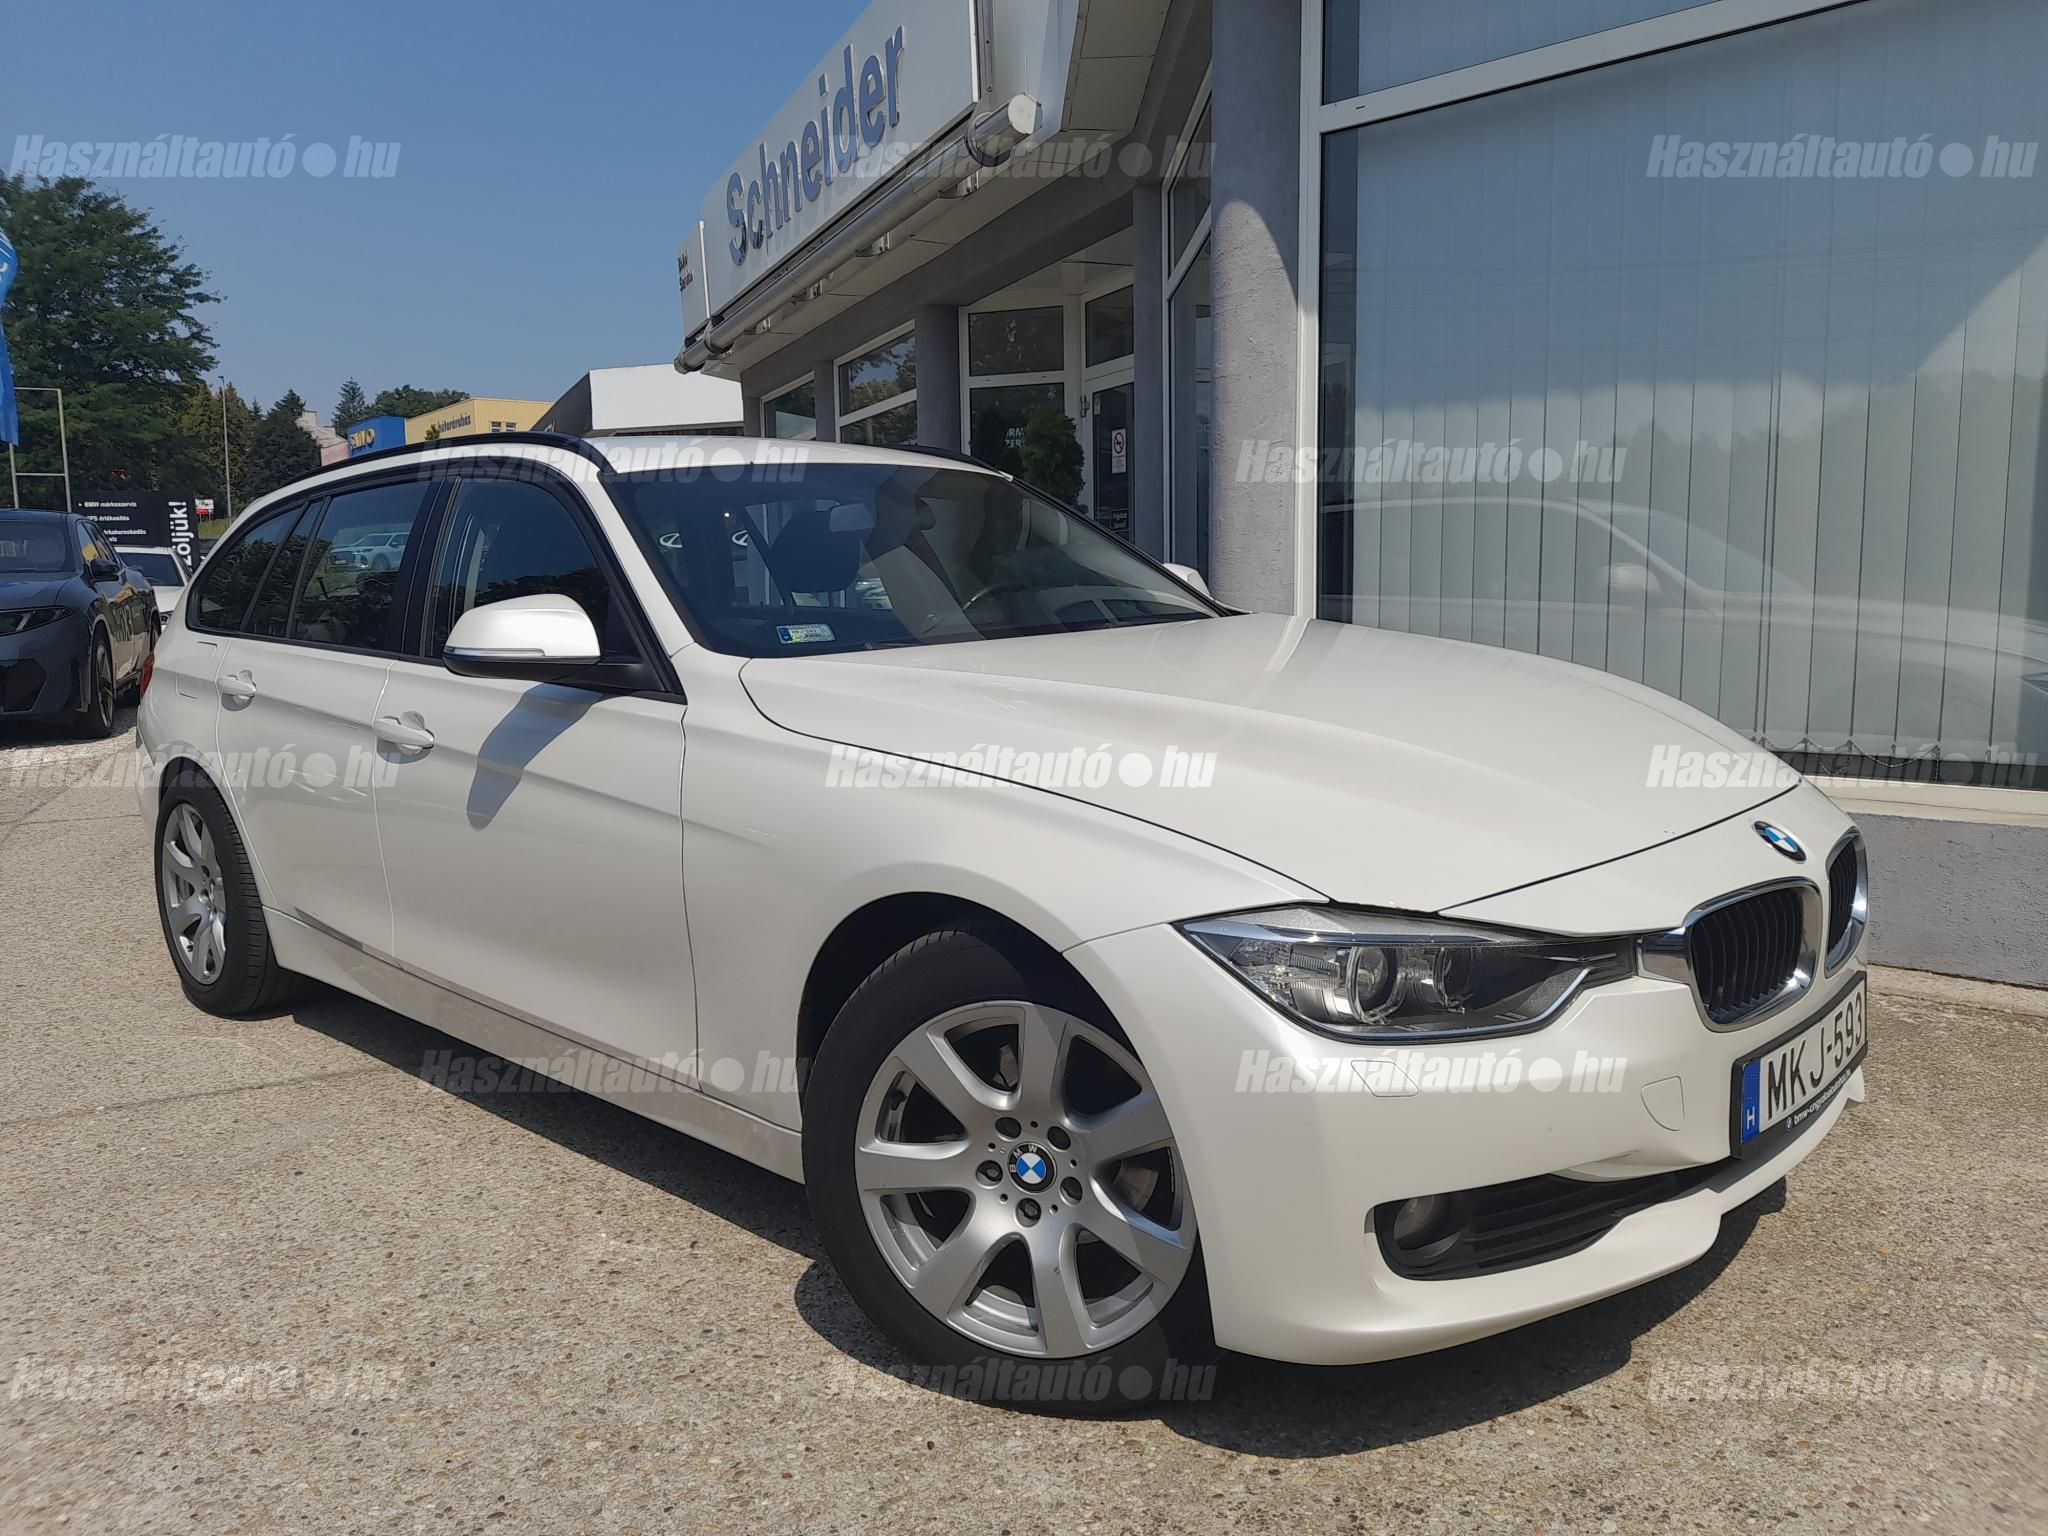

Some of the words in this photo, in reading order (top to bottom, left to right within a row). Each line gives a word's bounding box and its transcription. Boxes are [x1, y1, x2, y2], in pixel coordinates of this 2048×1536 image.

[725, 23, 906, 267] Schneider
[1746, 1106, 1756, 1130] H
[1767, 991, 1863, 1121] MKJ-593
